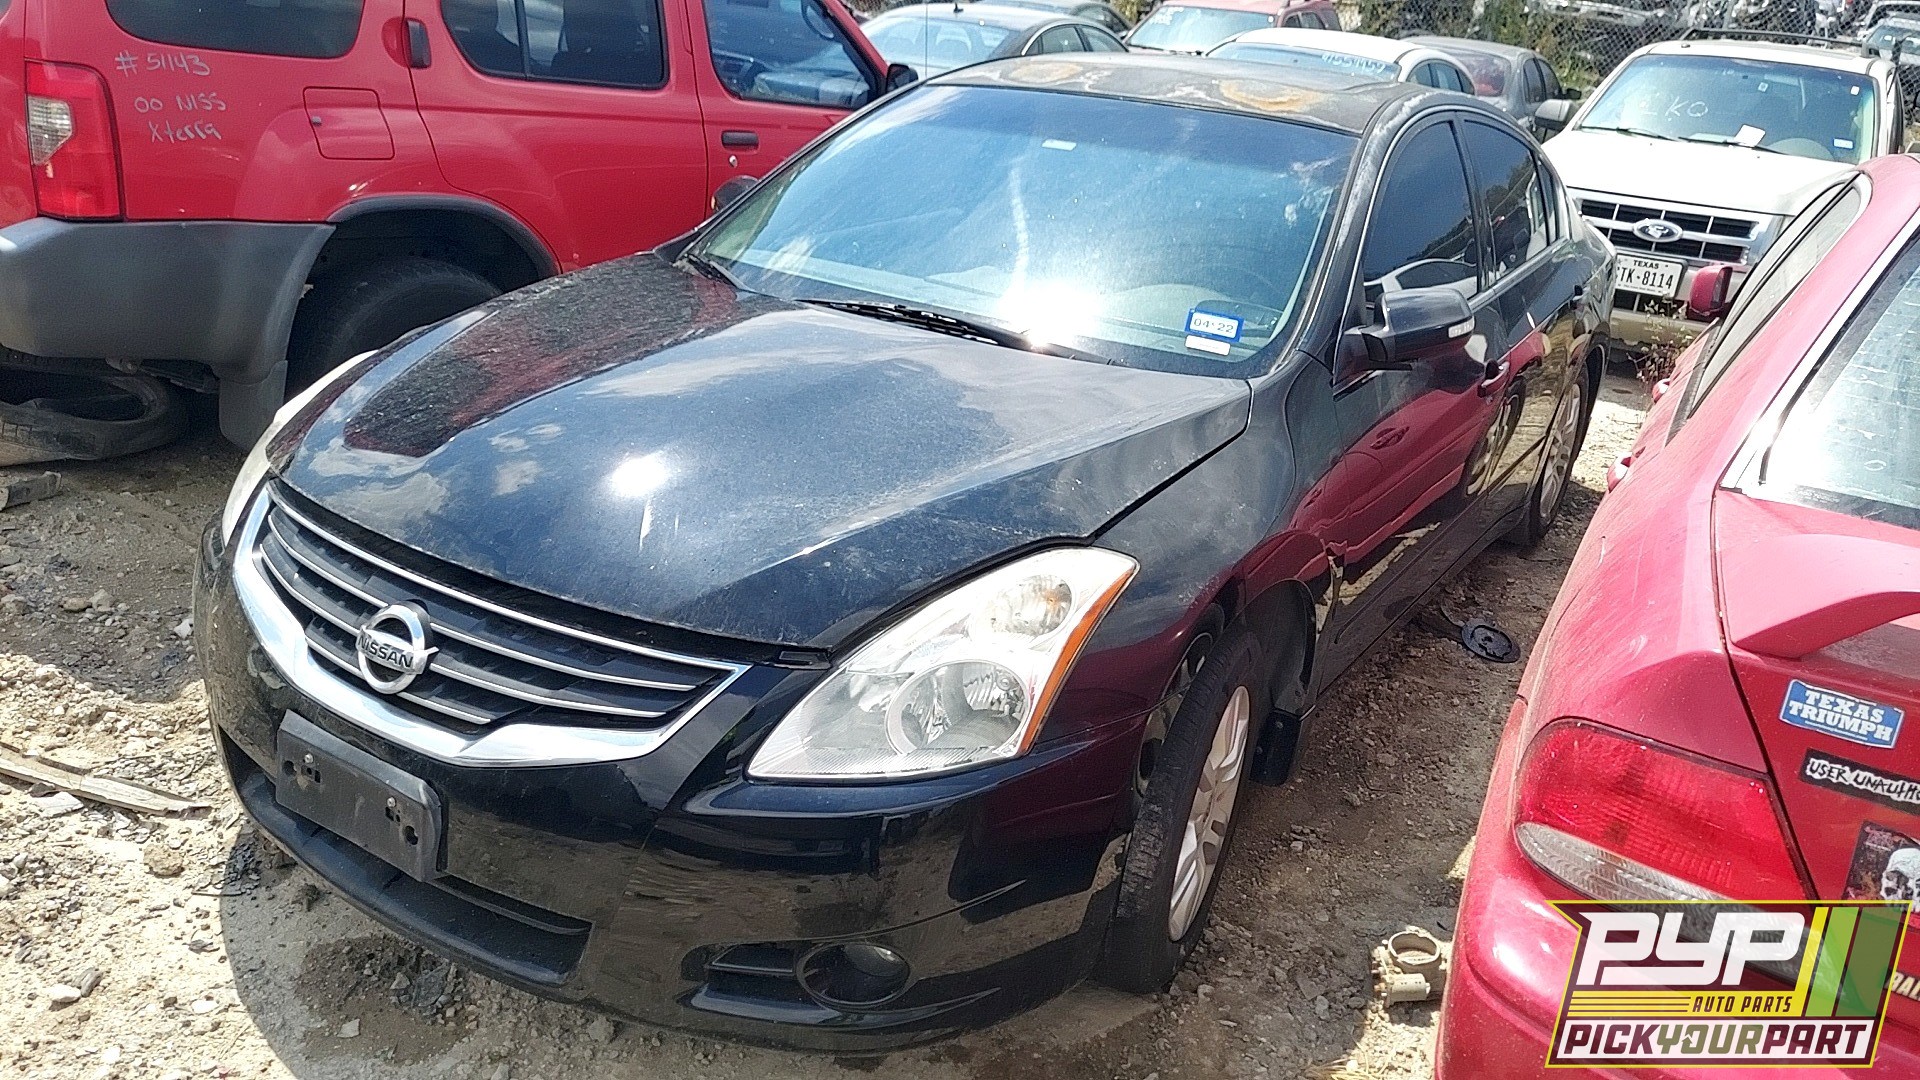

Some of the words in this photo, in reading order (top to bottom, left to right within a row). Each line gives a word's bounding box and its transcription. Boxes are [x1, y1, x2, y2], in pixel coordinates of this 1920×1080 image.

[1633, 260, 1660, 270] TEXAS
[357, 633, 414, 668] NISSAN
[1788, 700, 1894, 741] TRIUMPH
[1805, 690, 1885, 724] TEXAS
[1809, 759, 1849, 783] USER
